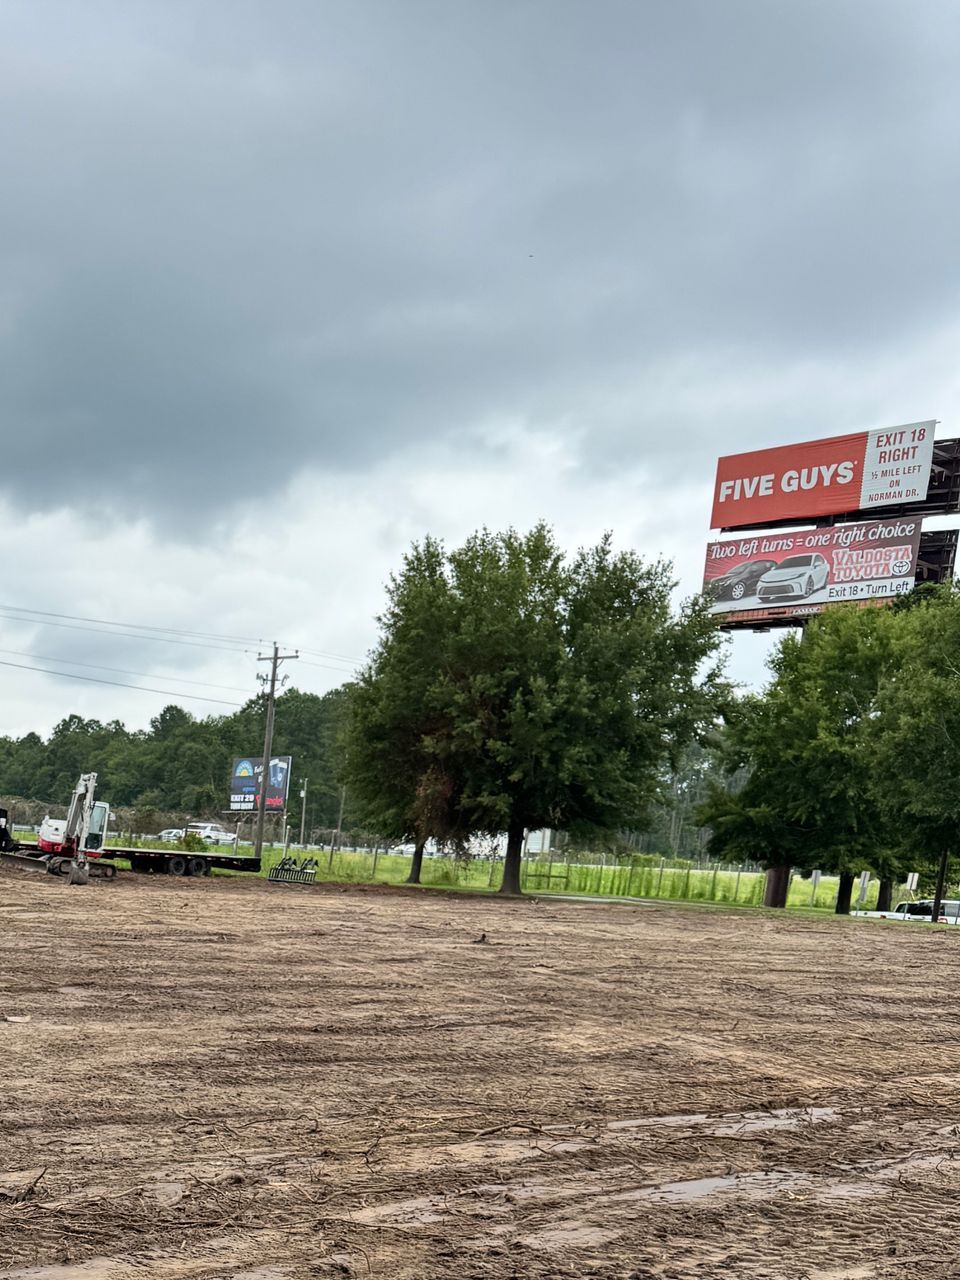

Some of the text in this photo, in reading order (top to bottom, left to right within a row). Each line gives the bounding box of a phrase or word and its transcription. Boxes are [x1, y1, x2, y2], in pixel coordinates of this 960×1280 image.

[876, 428, 926, 448] EXIT 18
[878, 446, 919, 464] RIGHT
[881, 467, 901, 478] MILE
[903, 465, 922, 475] LEFT
[719, 461, 855, 503] FIVE GUYS
[889, 480, 900, 488] ON
[868, 488, 919, 503] NORMAN DR.
[711, 545, 736, 559] Two
[738, 540, 758, 558] left
[761, 538, 794, 553] turns
[805, 533, 831, 548] one
[833, 526, 866, 547] right
[868, 522, 915, 540] choice
[832, 545, 913, 566] VALDOSTA
[834, 563, 893, 581] TOYOTA
[828, 581, 909, 597] Exit 18 Turn Left
